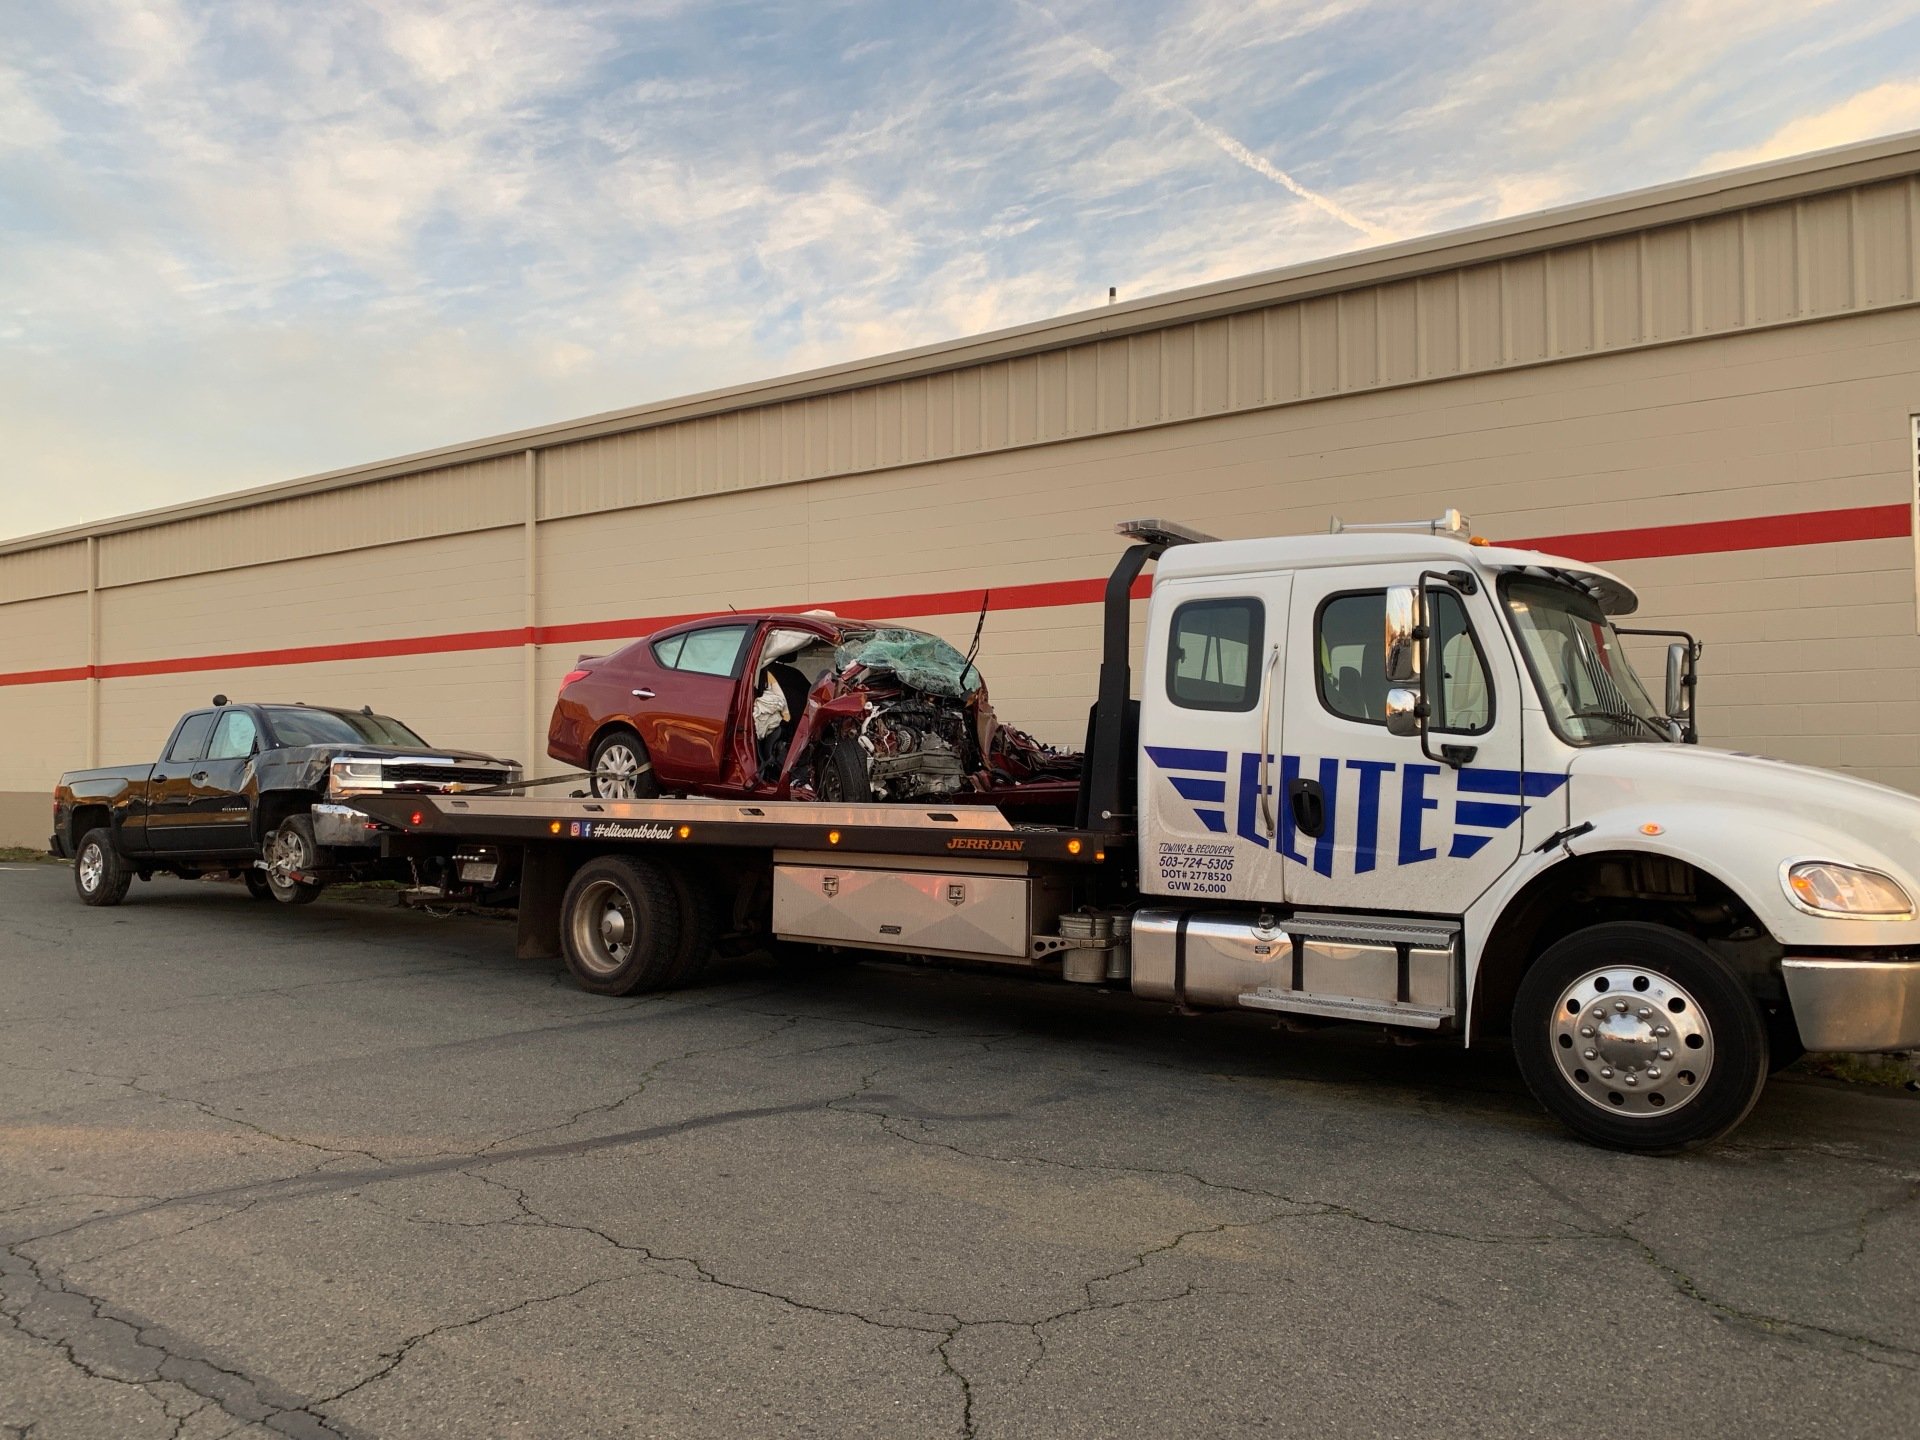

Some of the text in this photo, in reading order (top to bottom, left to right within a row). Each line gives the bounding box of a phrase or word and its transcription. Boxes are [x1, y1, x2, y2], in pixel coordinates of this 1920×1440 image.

[1237, 752, 1441, 879] ELITE
[1159, 843, 1235, 855] TOWING & RECOVERY
[1159, 856, 1234, 870] 503-724-5305
[1161, 869, 1232, 882] DOT# 2778520
[1168, 881, 1226, 893] GVW 26,000
